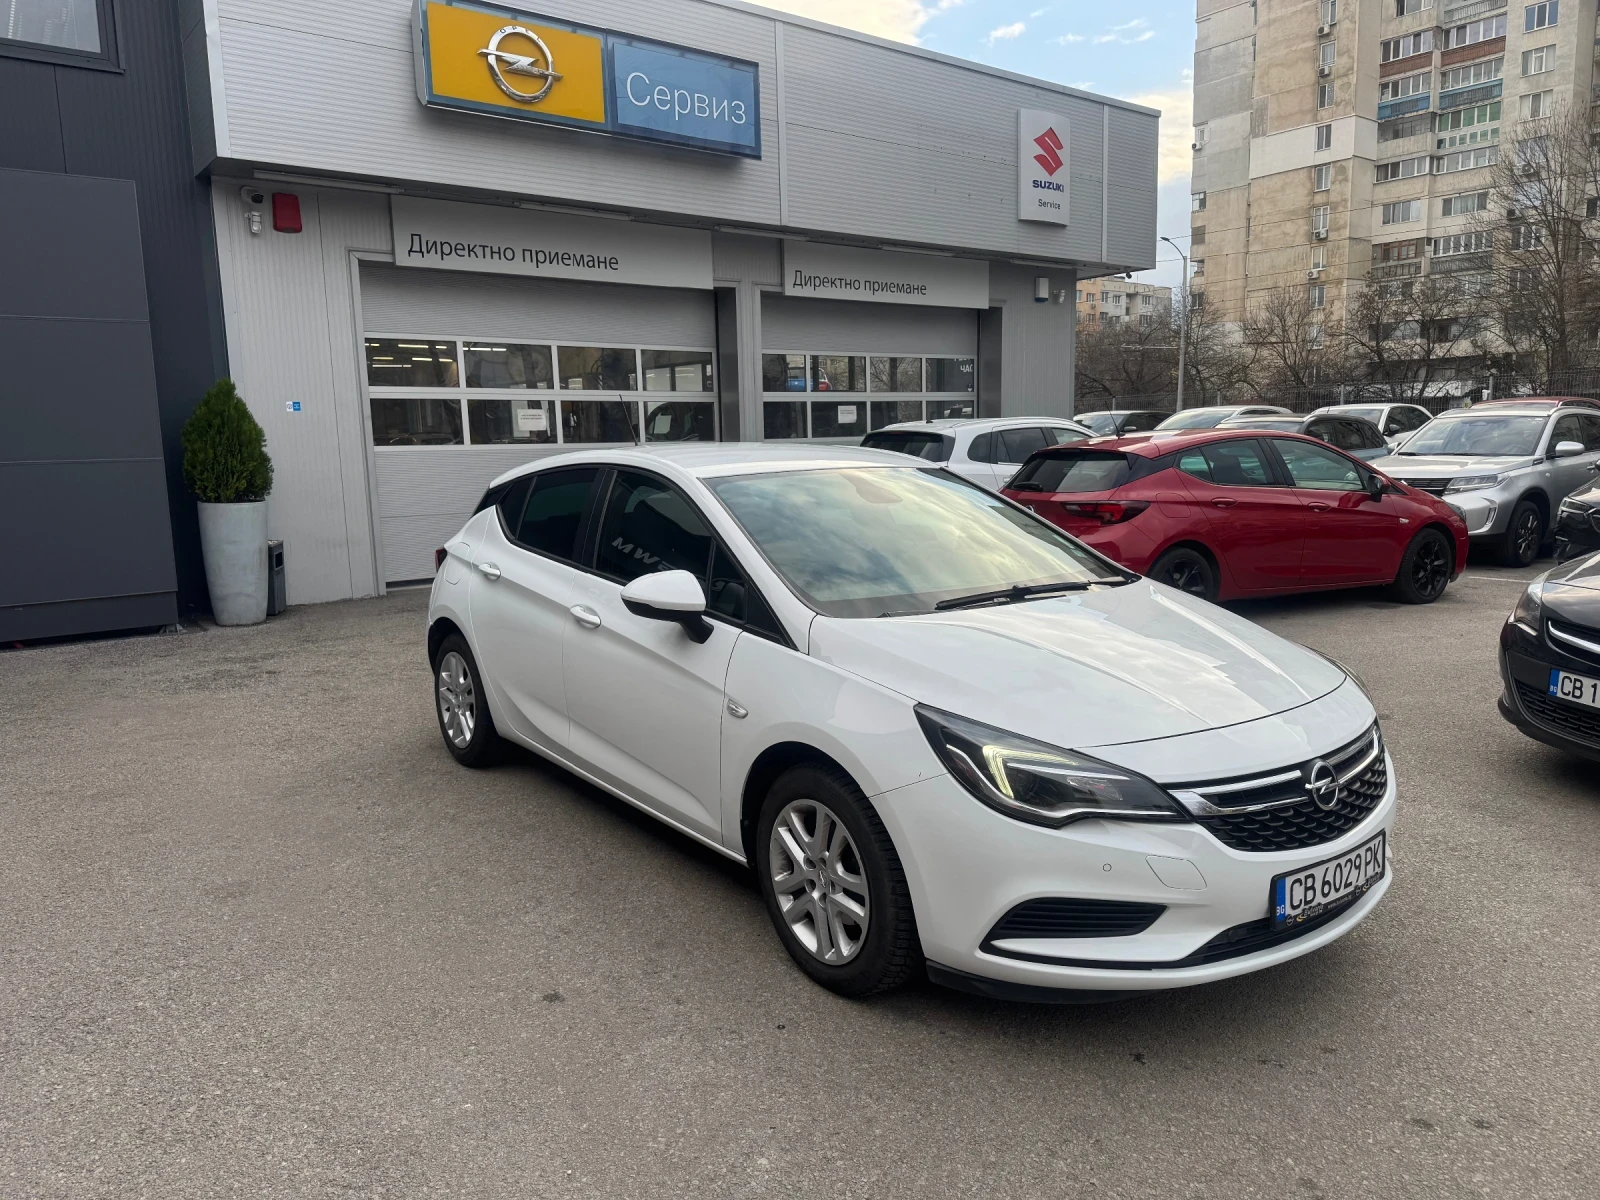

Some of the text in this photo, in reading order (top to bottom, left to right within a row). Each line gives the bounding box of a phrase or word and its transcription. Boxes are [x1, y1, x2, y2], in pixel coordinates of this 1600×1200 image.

[626, 71, 746, 124] Сервиз
[1032, 179, 1065, 193] SUZUKI
[1038, 198, 1061, 210] Service
[408, 233, 619, 272] Директно приемане
[793, 269, 927, 296] Директно приемане
[1560, 675, 1583, 699] CB
[1290, 840, 1382, 910] CB 6029 PK
